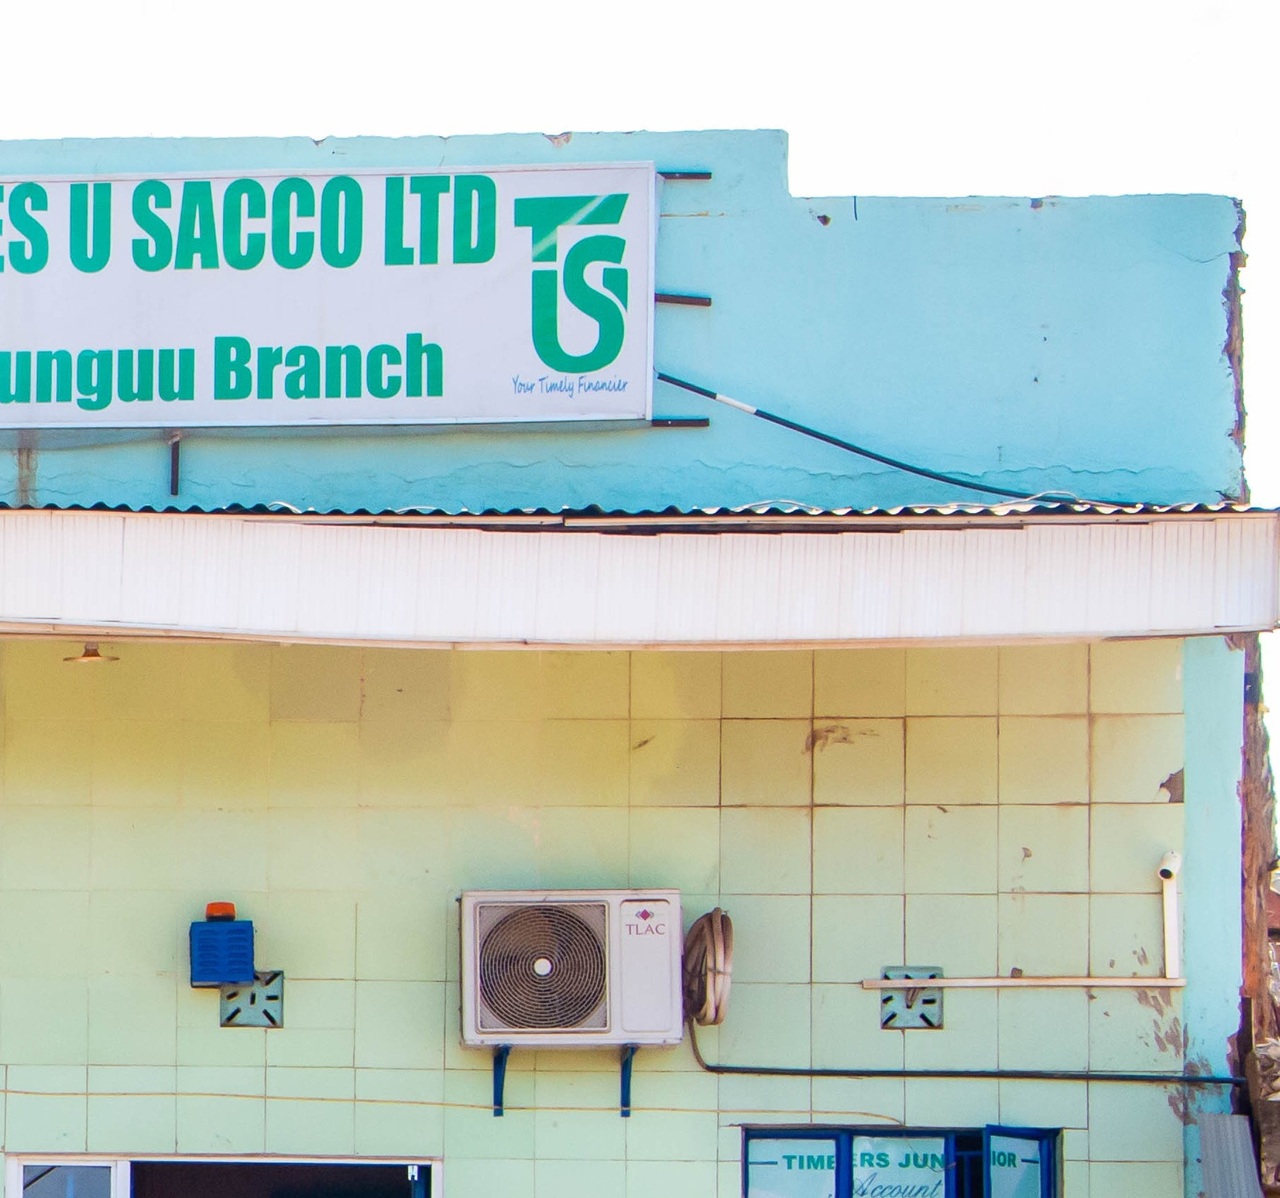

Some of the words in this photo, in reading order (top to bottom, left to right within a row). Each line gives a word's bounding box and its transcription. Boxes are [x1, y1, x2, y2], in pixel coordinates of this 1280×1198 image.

[70, 182, 112, 274] U
[131, 174, 364, 273] SACCO
[385, 174, 497, 266] LTD
[213, 332, 444, 401] Branch
[512, 374, 535, 394] Your
[538, 375, 574, 398] Timely
[577, 374, 628, 394] Financier
[625, 923, 666, 936] TLAC
